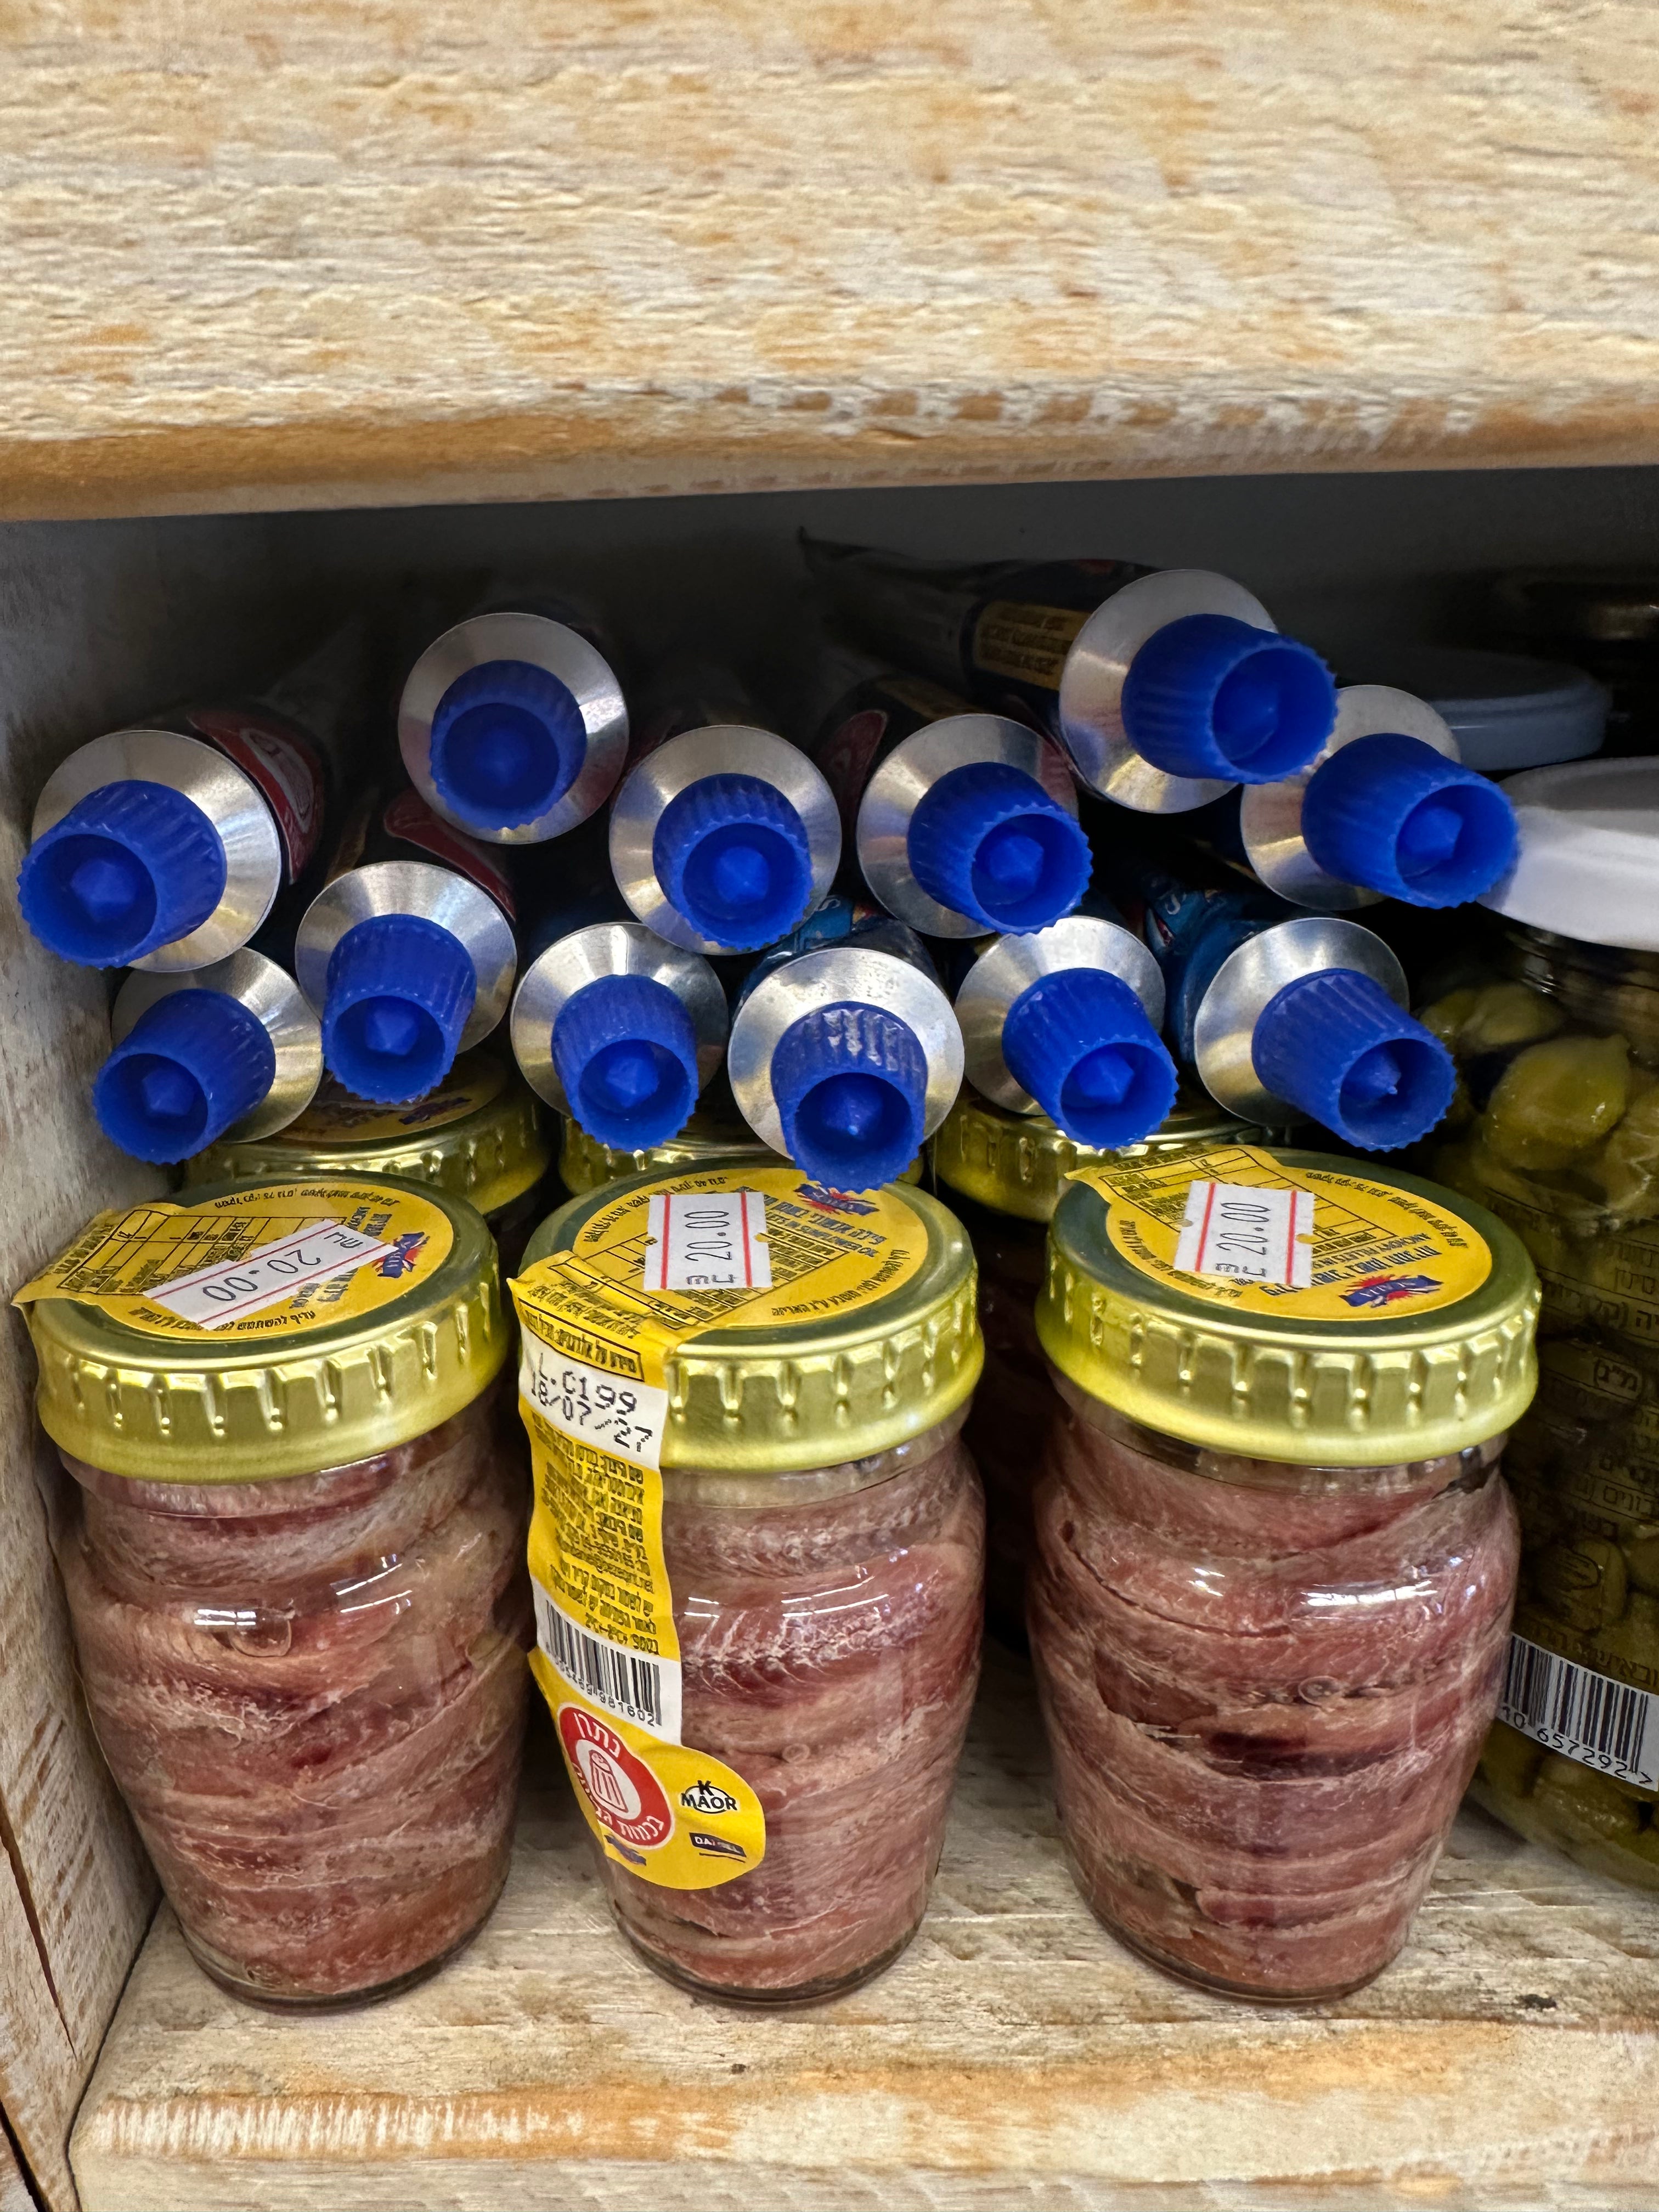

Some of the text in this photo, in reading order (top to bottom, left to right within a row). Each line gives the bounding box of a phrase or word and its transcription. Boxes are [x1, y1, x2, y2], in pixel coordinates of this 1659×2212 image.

[685, 1209, 733, 1263] 20.00
[1215, 1201, 1271, 1256] 20.00
[202, 1249, 322, 1302] 20.00
[290, 1310, 317, 1324] עדיף
[531, 1370, 653, 1453] 18/07/27
[574, 1712, 622, 1758] נתרן
[1536, 1727, 1629, 1780] 657292
[681, 1792, 738, 1812] MAOR
[697, 1780, 713, 1797] K
[617, 1815, 664, 1841] בכמות
